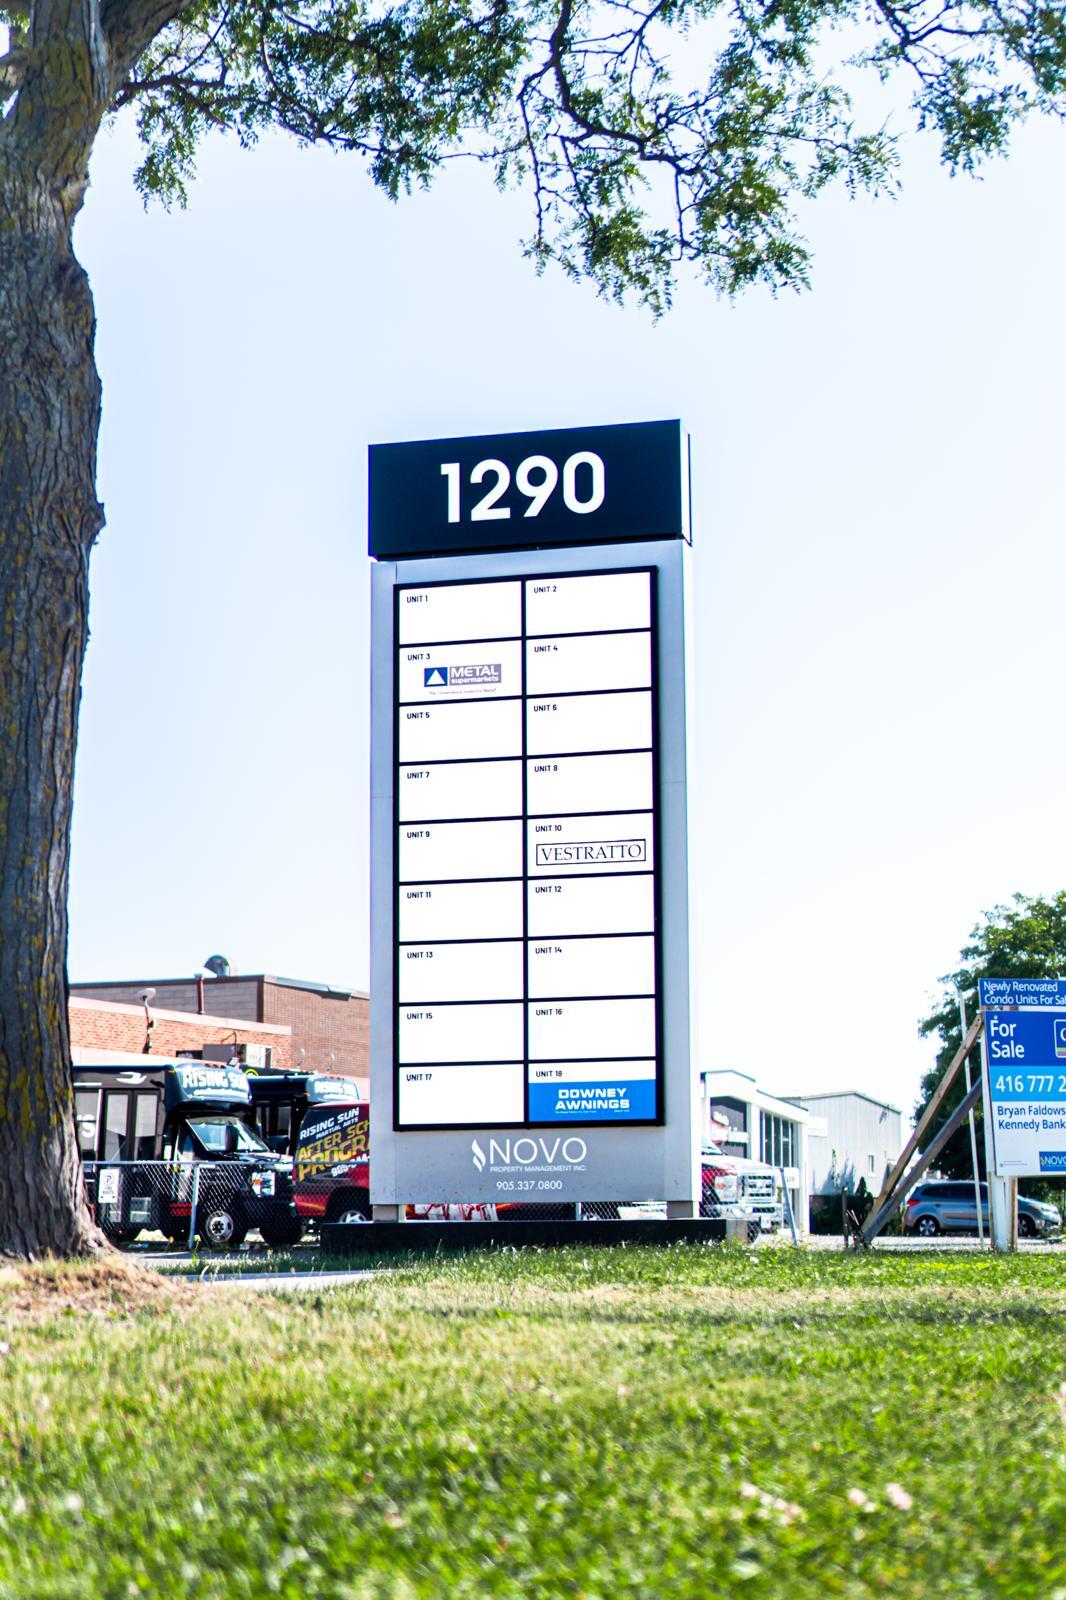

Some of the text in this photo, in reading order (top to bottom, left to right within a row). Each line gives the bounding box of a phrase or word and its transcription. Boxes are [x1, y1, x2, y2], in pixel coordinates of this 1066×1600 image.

[440, 451, 605, 523] 1290
[552, 585, 557, 593] 2
[406, 594, 429, 604] UNIT 1
[533, 644, 559, 653] UNIT 4
[407, 652, 431, 662] UNIT 3
[451, 665, 499, 678] METAL
[451, 675, 499, 684] supermarkets
[533, 703, 558, 713] UNIT 6
[406, 711, 431, 720] UNIT 5
[534, 764, 558, 773] UNIT 8
[406, 771, 430, 780] UNIT 7
[535, 824, 562, 833] UNIT 10
[406, 830, 431, 839] UNIT 9
[541, 843, 642, 862] VESTRATTO
[534, 885, 562, 894] UNIT 12
[406, 891, 432, 899] UNIT 11
[406, 951, 434, 960] UNIT 13
[534, 946, 553, 955] UNIT
[983, 981, 1058, 994] Newly Renovated
[984, 993, 1013, 1004] Condo
[1015, 994, 1039, 1005] Units
[1040, 995, 1053, 1005] For
[406, 1012, 433, 1020] UNIT 15
[535, 1008, 563, 1017] UNIT 16
[990, 1020, 1017, 1037] For
[991, 1040, 1025, 1058] Sale
[182, 1070, 229, 1088] RISING
[406, 1073, 433, 1082] UNIT 17
[535, 1070, 563, 1078] UNIT 18
[995, 1075, 1066, 1092] 416 777 2
[558, 1088, 627, 1099] DOWNEY
[555, 1099, 630, 1111] AWNINGS
[997, 1106, 1026, 1118] Bryan
[300, 1107, 360, 1140] RISING SUN
[316, 1117, 359, 1139] MARTIAL ARTS
[998, 1120, 1040, 1132] Kennedy
[299, 1132, 342, 1162] AFTER
[490, 1137, 587, 1164] NOVO
[573, 1164, 587, 1172] INC.
[496, 1180, 563, 1191] 905.337.0800
